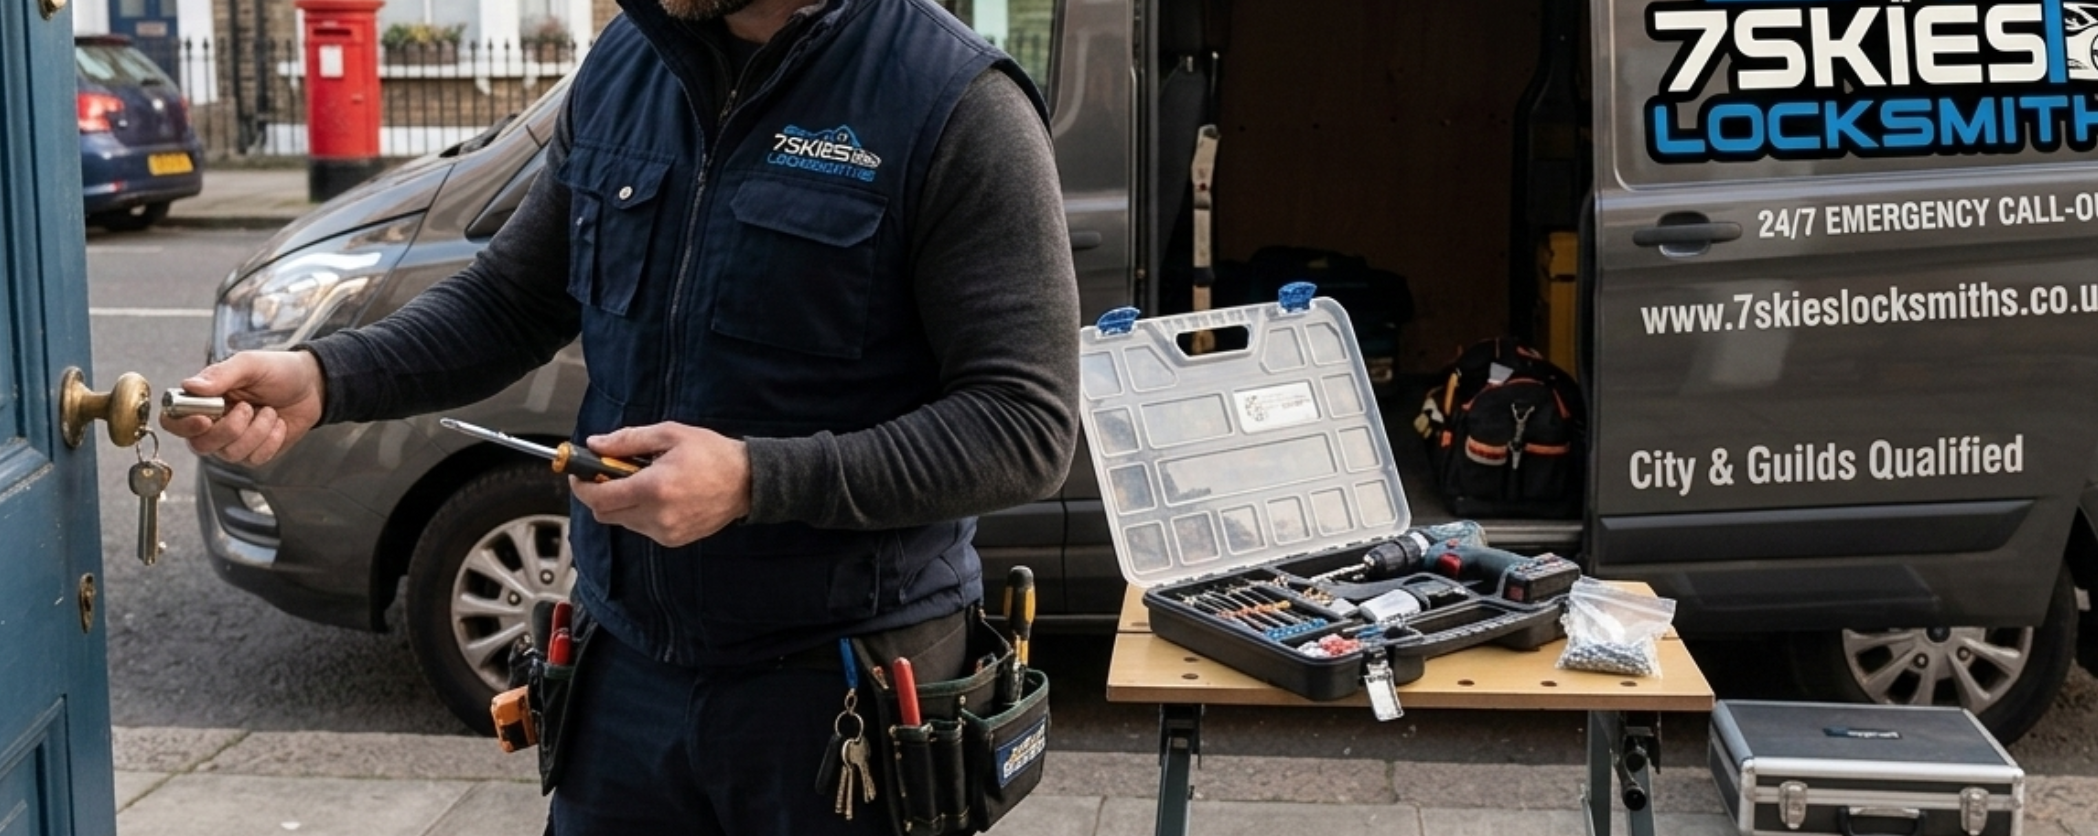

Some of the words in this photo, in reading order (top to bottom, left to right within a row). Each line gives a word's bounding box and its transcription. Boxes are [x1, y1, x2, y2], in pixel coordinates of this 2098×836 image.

[1654, 4, 2047, 92] 7SKIES
[773, 133, 853, 162] 7SKIES
[1758, 208, 1816, 240] 24/7
[1826, 198, 1990, 235] EMERGENCY
[1999, 191, 2098, 225] CALL-O
[1629, 450, 1697, 496] City
[1708, 447, 1735, 486] &
[1747, 442, 1857, 484] Guilds
[1869, 434, 2024, 480] Qualified
